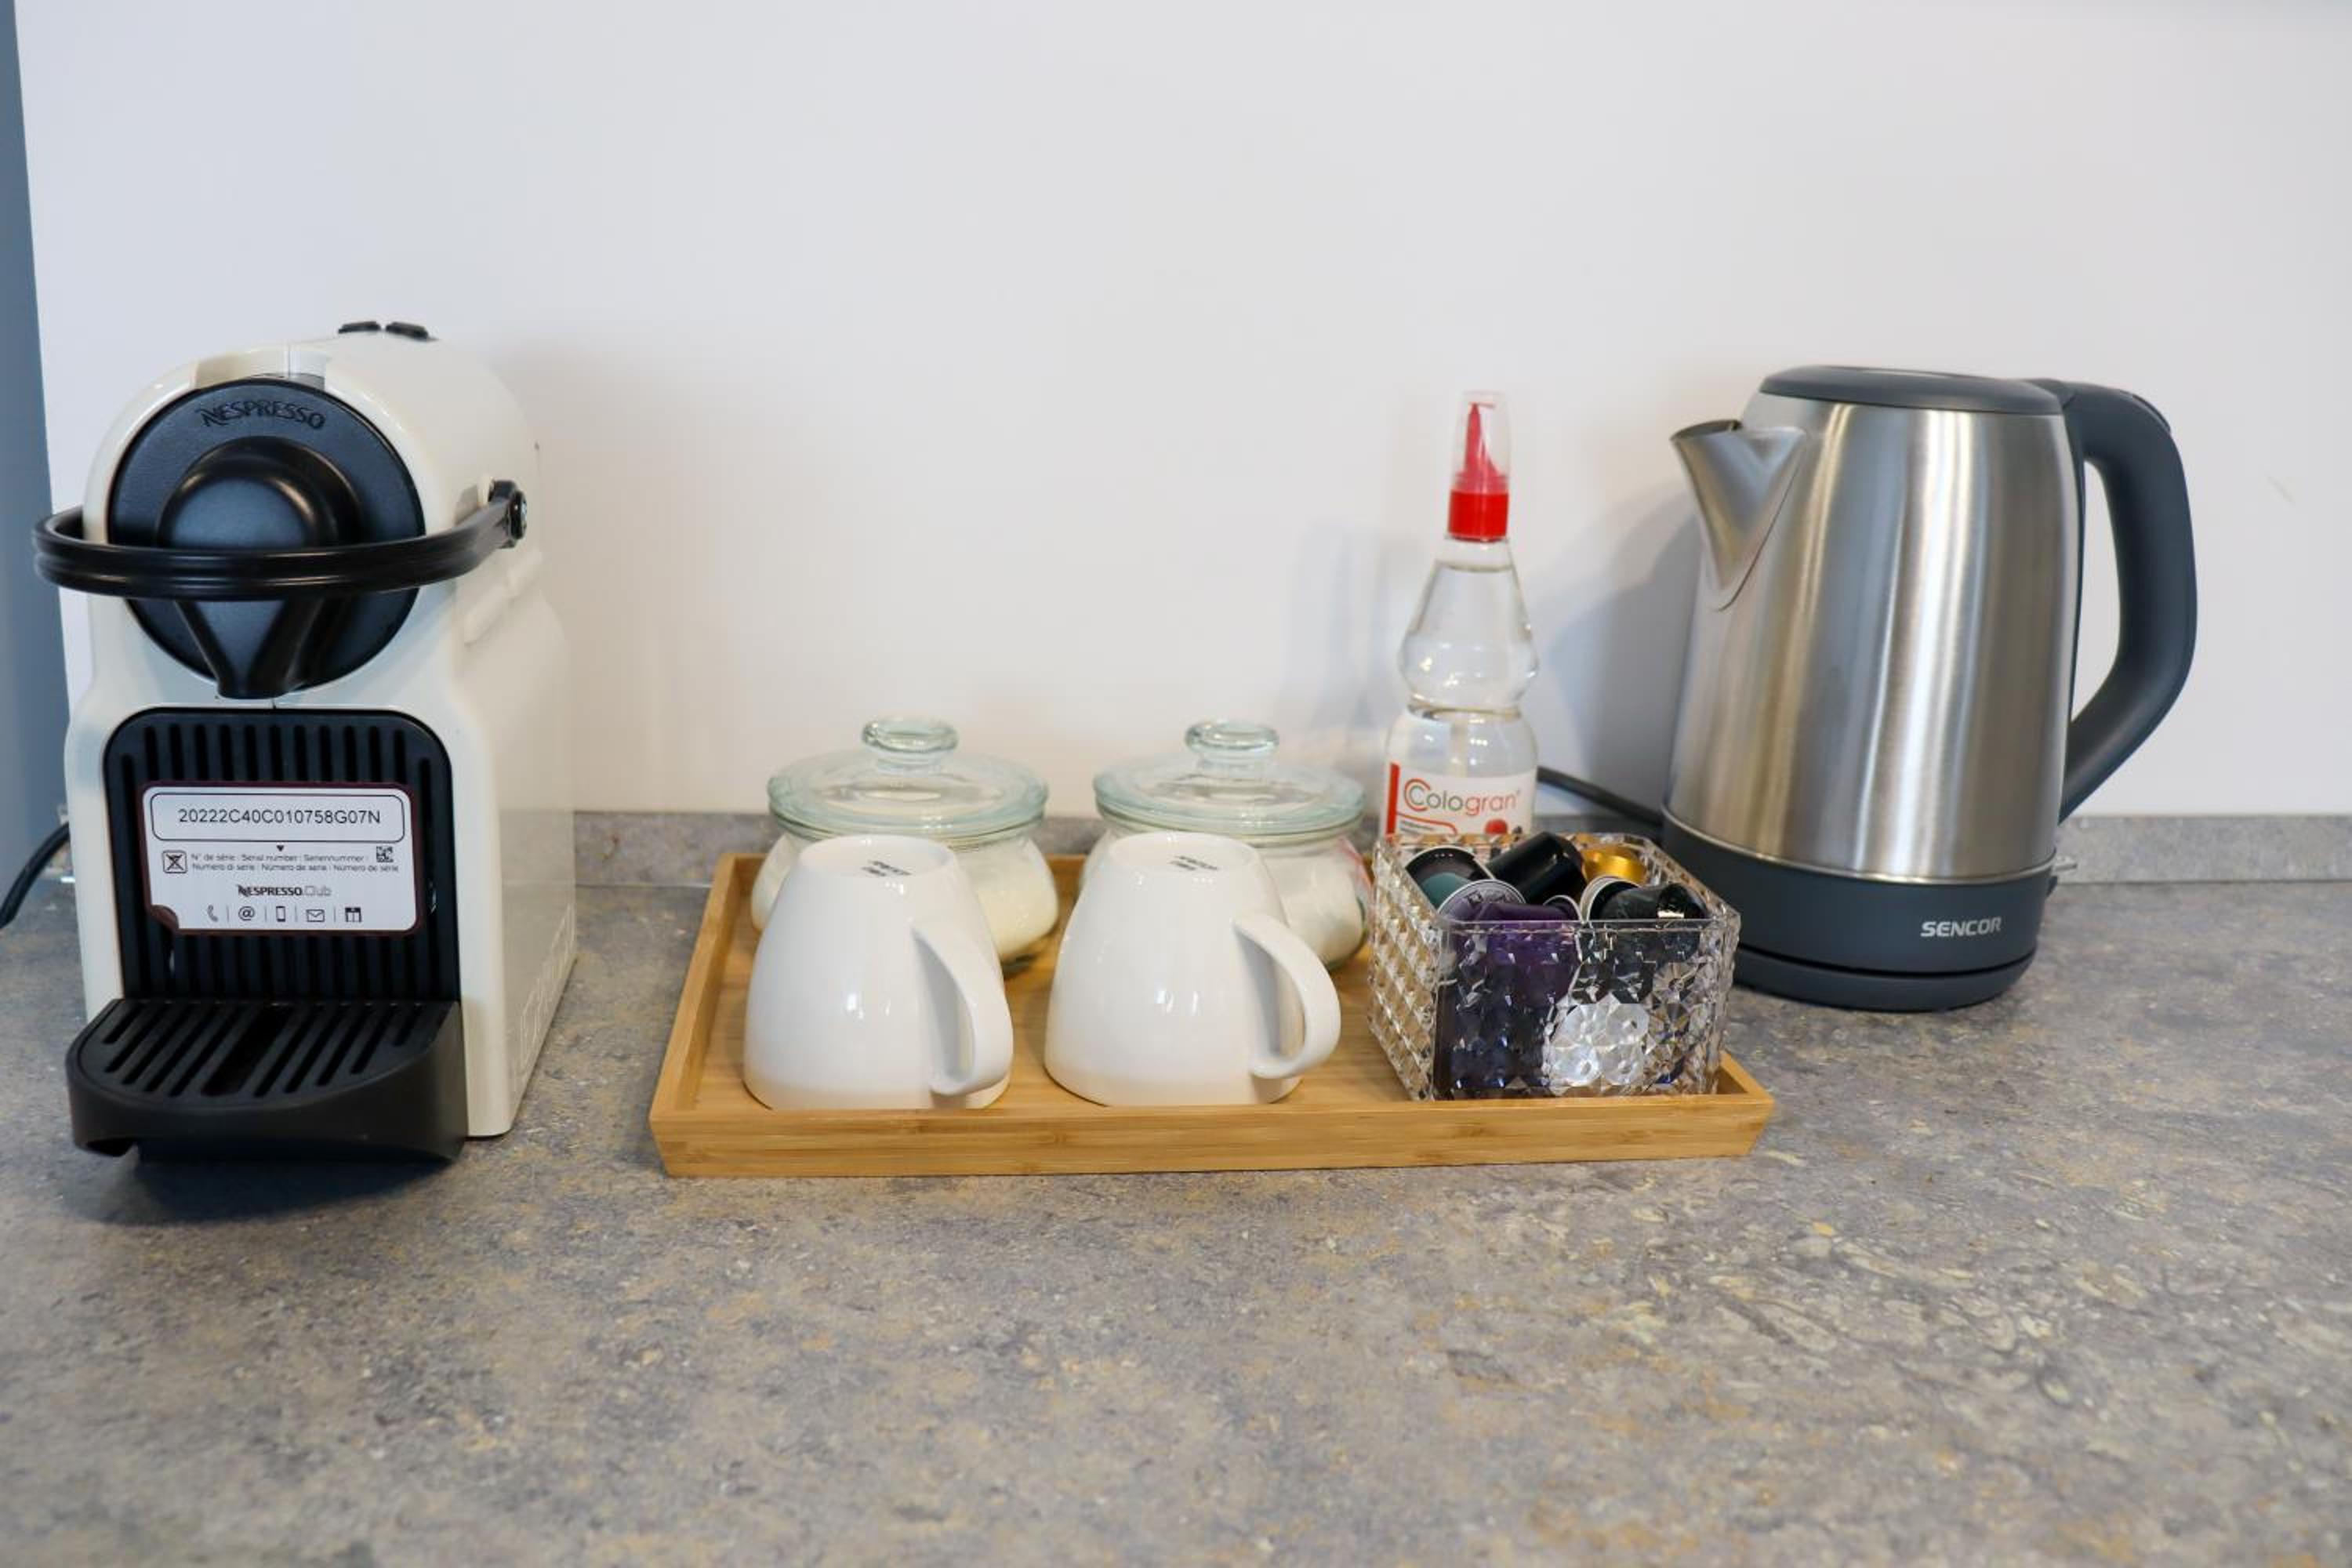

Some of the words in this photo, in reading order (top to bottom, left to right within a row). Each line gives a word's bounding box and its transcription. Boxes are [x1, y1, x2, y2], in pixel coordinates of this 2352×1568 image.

[196, 400, 325, 430] NESPRESSO
[178, 808, 381, 824] 20222C40C010758G07N
[1920, 916, 2002, 938] SENCOR
